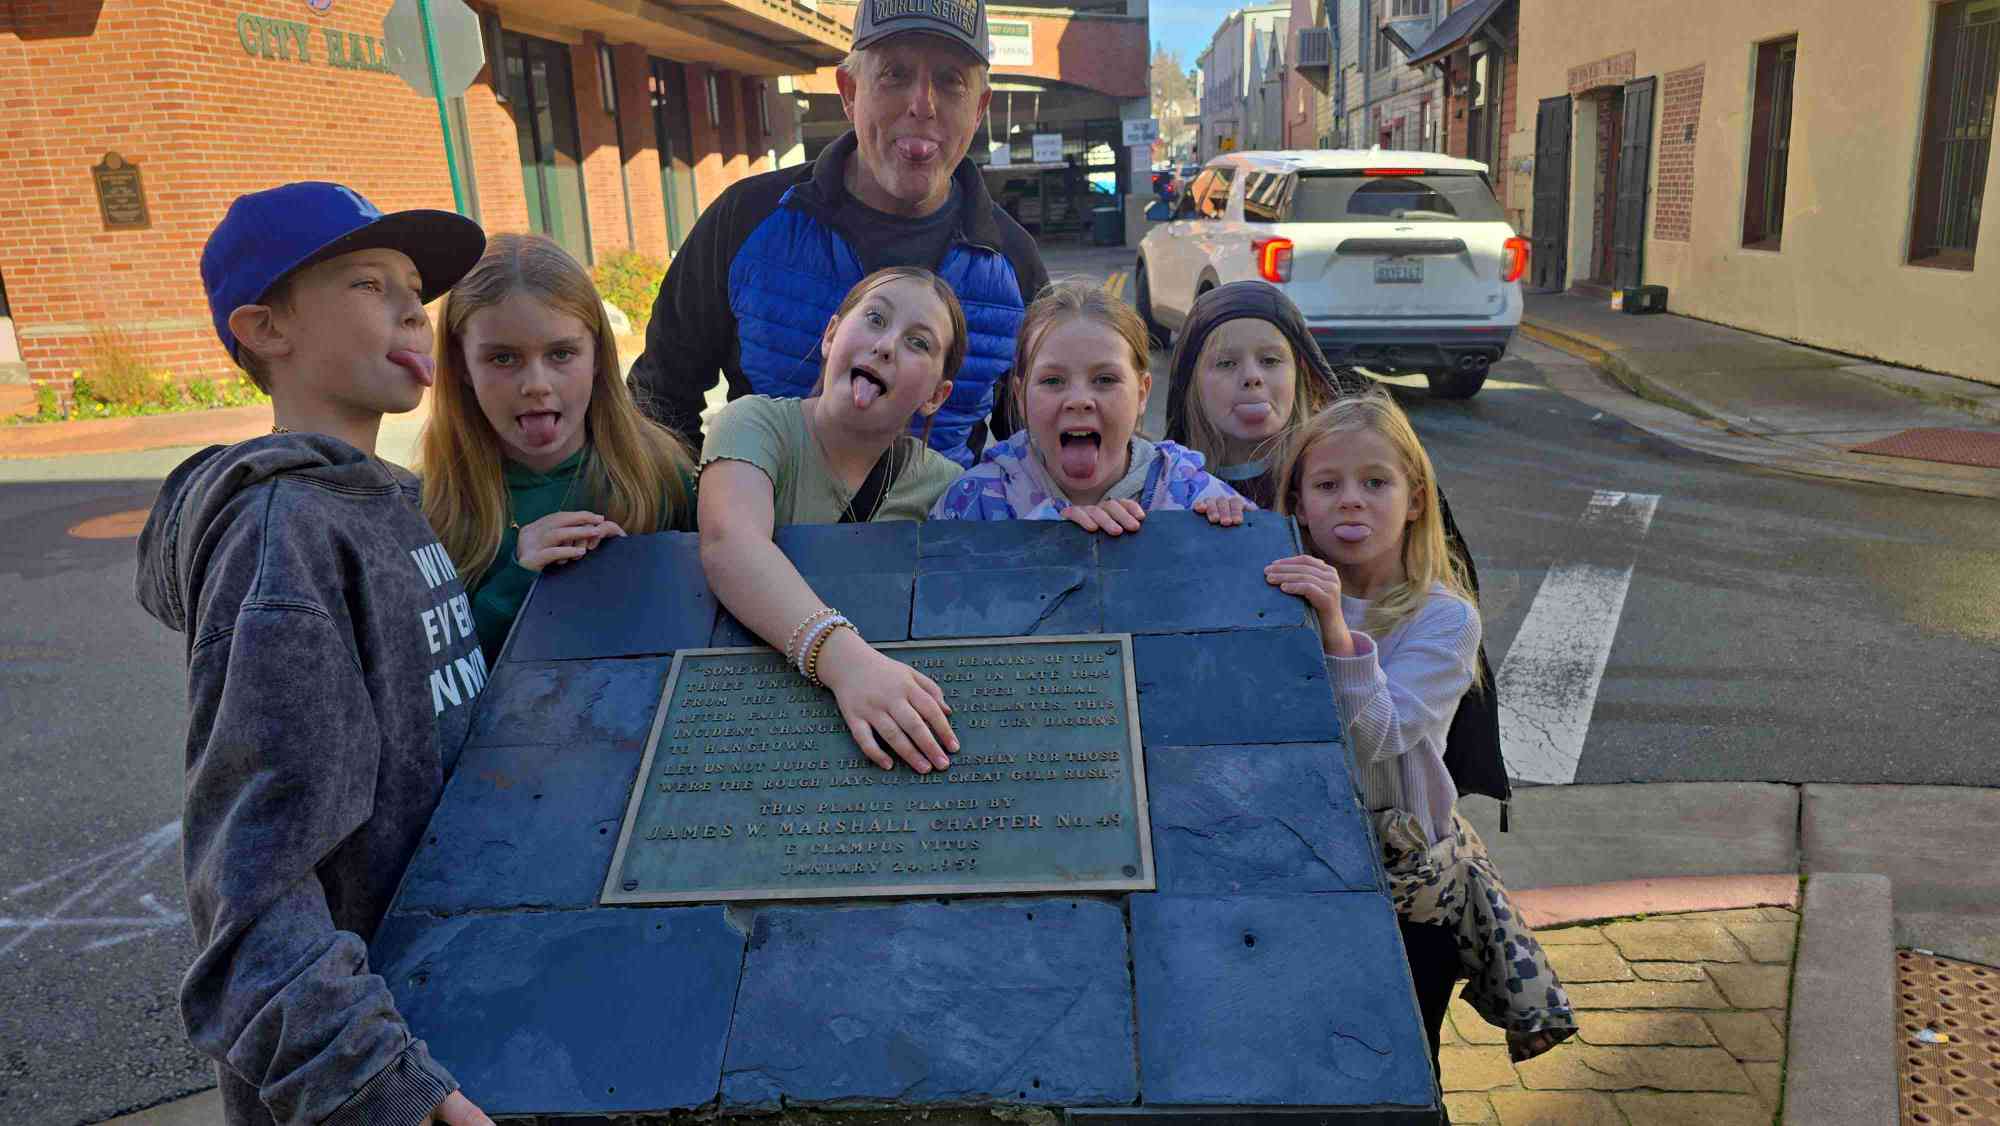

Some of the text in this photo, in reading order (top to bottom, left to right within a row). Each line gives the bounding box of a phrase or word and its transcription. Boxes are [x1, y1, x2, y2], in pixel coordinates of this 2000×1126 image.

[237, 13, 311, 62] CITY
[912, 656, 945, 668] THE
[957, 655, 1034, 667] REMAINS
[1044, 654, 1064, 665] OF
[1072, 654, 1104, 664] THE
[687, 680, 744, 692] THREE
[984, 671, 1005, 682] IN
[1015, 671, 1060, 681] LATE
[676, 712, 736, 723] AFTER
[747, 711, 790, 720] FAIR
[800, 708, 840, 719] TRIA
[1073, 700, 1115, 710] THIS
[680, 697, 728, 708] FROM
[743, 695, 777, 705] THE
[672, 727, 760, 739] INCIDENT
[968, 719, 992, 729] OF
[999, 718, 1033, 728] DRY
[1045, 715, 1119, 727] DIGGINS
[664, 763, 697, 775] LET
[704, 762, 726, 774] US
[730, 761, 766, 773] NOT
[769, 759, 830, 772] JUDGE
[949, 753, 1017, 766] ARSHLY
[1025, 751, 1060, 763] FOR
[1064, 751, 1120, 762] THOSE
[657, 782, 713, 793] WERE
[720, 780, 753, 791] THE
[761, 777, 820, 791] ROUGH
[829, 775, 874, 787] DAYS
[911, 773, 945, 785] THE
[947, 770, 1003, 784] GREAT
[1009, 768, 1058, 781] GOLD
[760, 797, 1016, 816] THIS PLAQUE PLACED BY
[645, 822, 736, 841] JAMES
[746, 822, 768, 838] W.
[777, 818, 917, 837] MARSHALL
[928, 815, 1043, 832] CHAPTER
[1095, 813, 1121, 828] 49
[784, 838, 982, 856] E CLAMPUS VITUS
[780, 861, 882, 876] JANUARY
